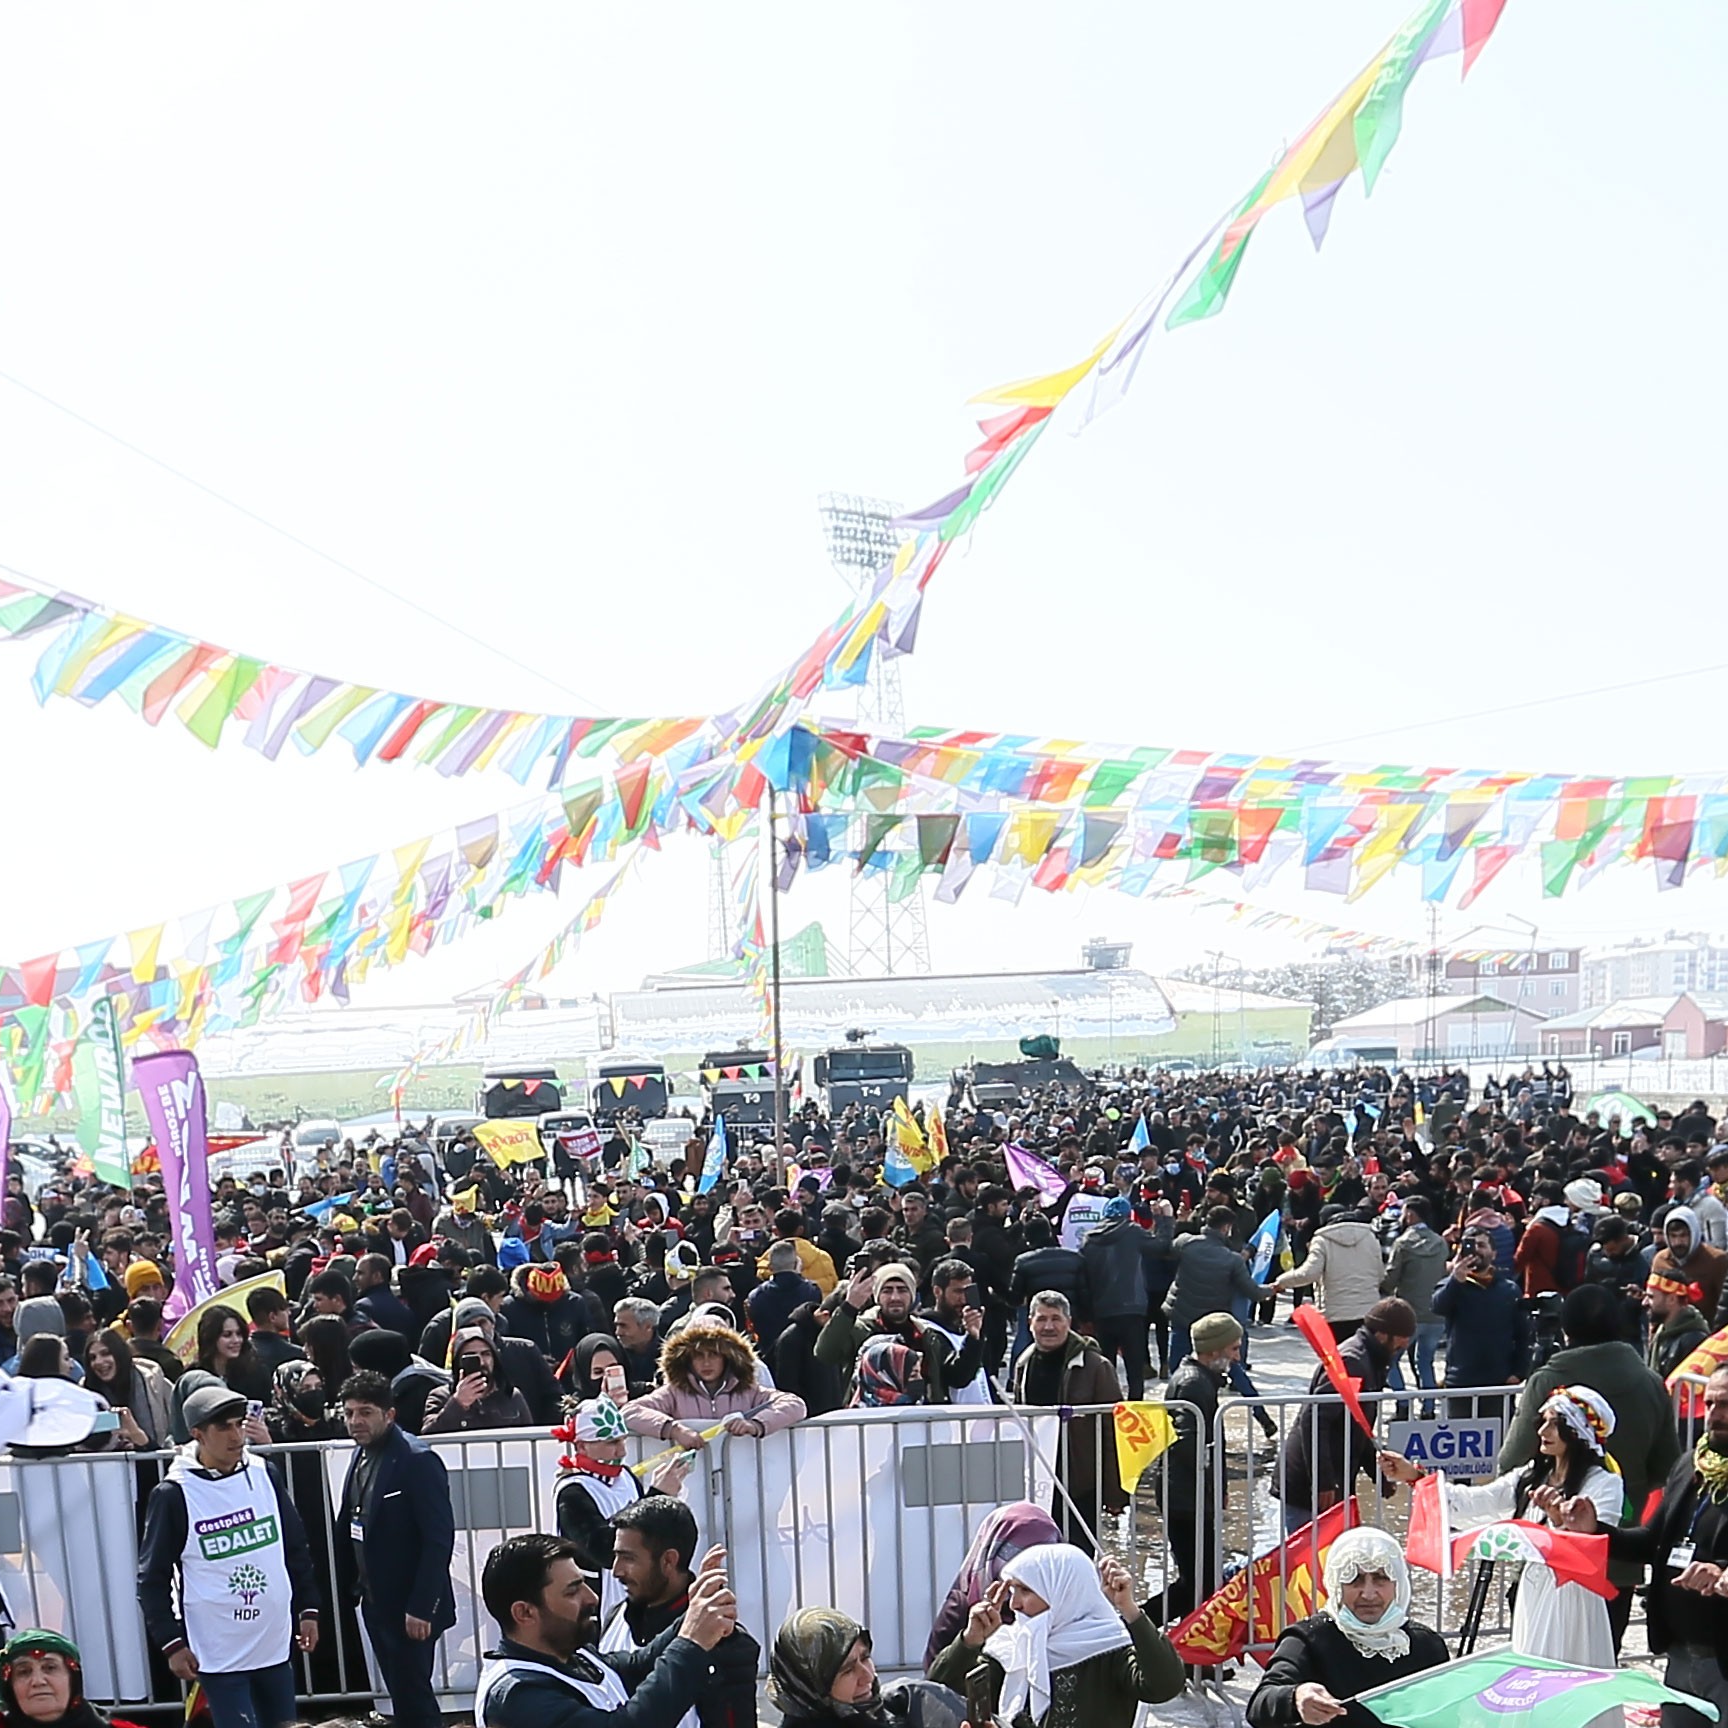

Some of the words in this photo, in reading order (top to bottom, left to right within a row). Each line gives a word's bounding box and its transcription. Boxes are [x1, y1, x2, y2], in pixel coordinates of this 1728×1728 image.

[1404, 1425, 1494, 1460] AĞRI
[199, 1510, 253, 1533] destpêkê
[203, 1521, 272, 1556] EDALET
[233, 1609, 261, 1621] HDP
